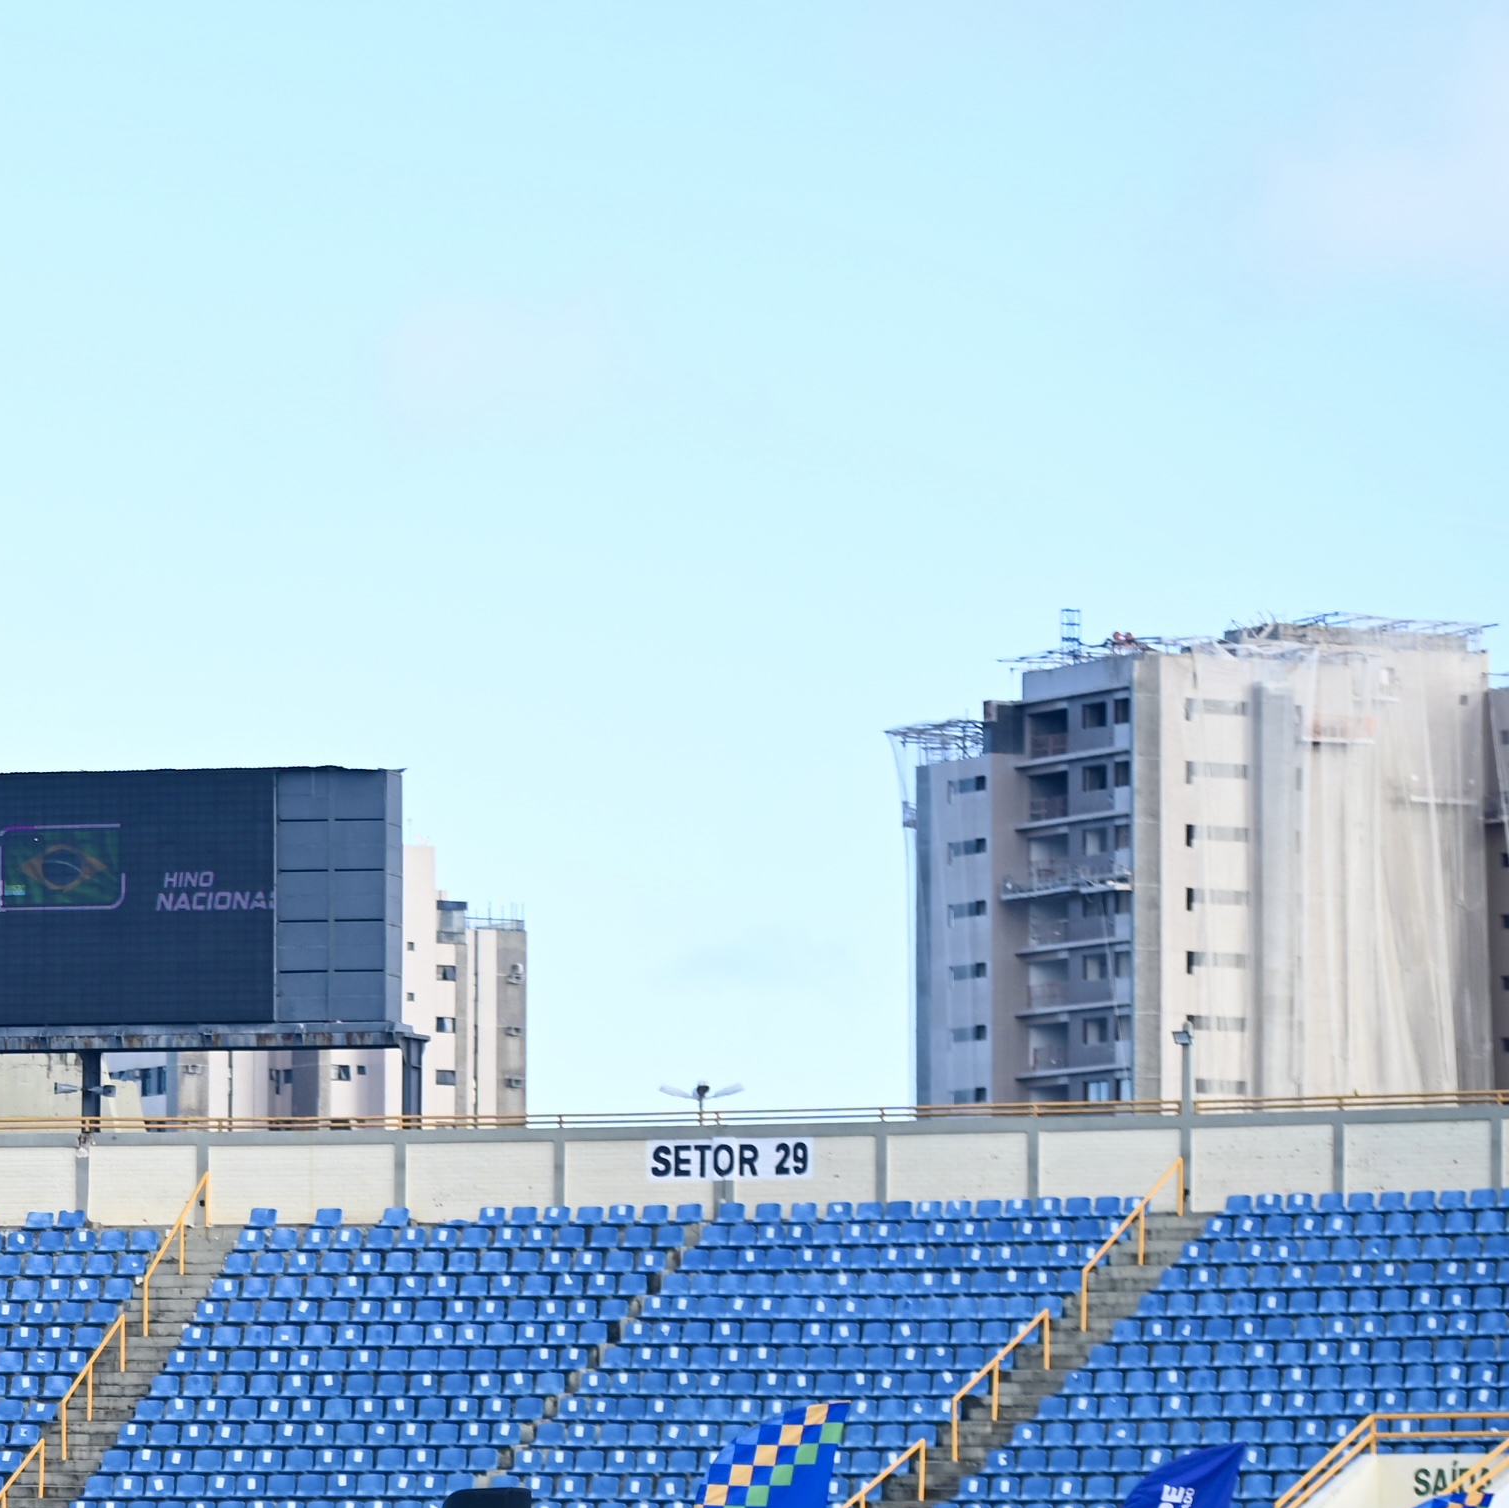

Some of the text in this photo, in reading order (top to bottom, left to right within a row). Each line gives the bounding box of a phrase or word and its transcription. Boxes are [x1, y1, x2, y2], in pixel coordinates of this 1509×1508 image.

[164, 871, 214, 888] HINO
[651, 1142, 809, 1178] SETOR 29
